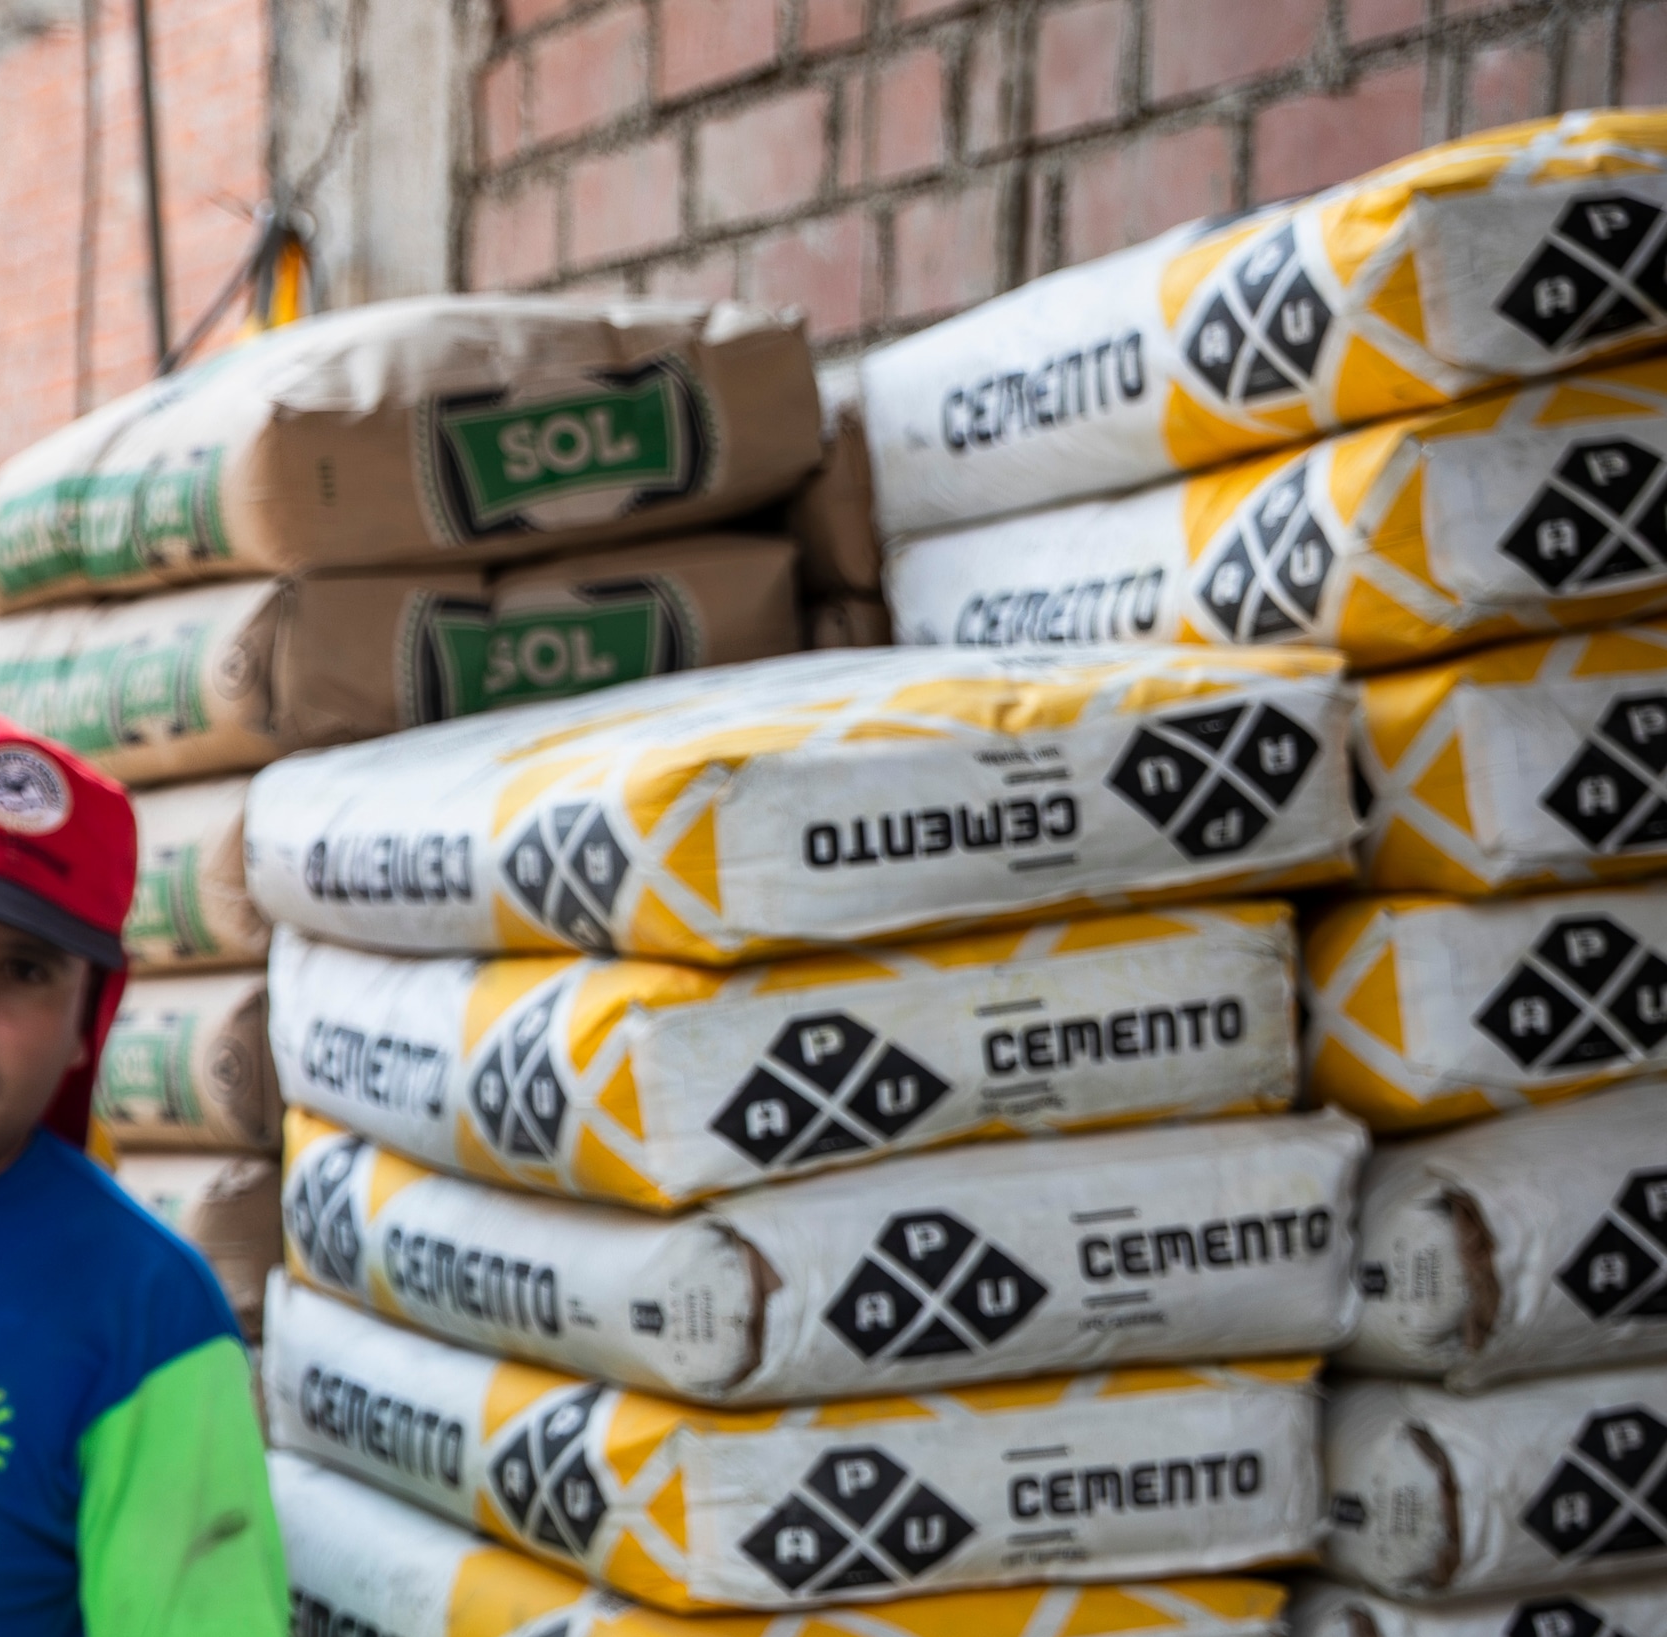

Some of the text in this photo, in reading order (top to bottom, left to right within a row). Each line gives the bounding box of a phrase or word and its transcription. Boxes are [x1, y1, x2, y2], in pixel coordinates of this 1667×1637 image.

[942, 331, 1144, 451] CEMENTO
[496, 405, 637, 484] SOL
[956, 568, 1164, 644] CEMENTO
[485, 624, 616, 696] SOL
[804, 793, 1080, 871] CEMENTO
[982, 997, 1246, 1077] CEMENTO
[383, 1225, 562, 1338] CEMENTO
[1077, 1206, 1333, 1283] CEMENTO
[298, 1364, 467, 1490] CEMENTO
[1006, 1449, 1263, 1523] CEMENTO
